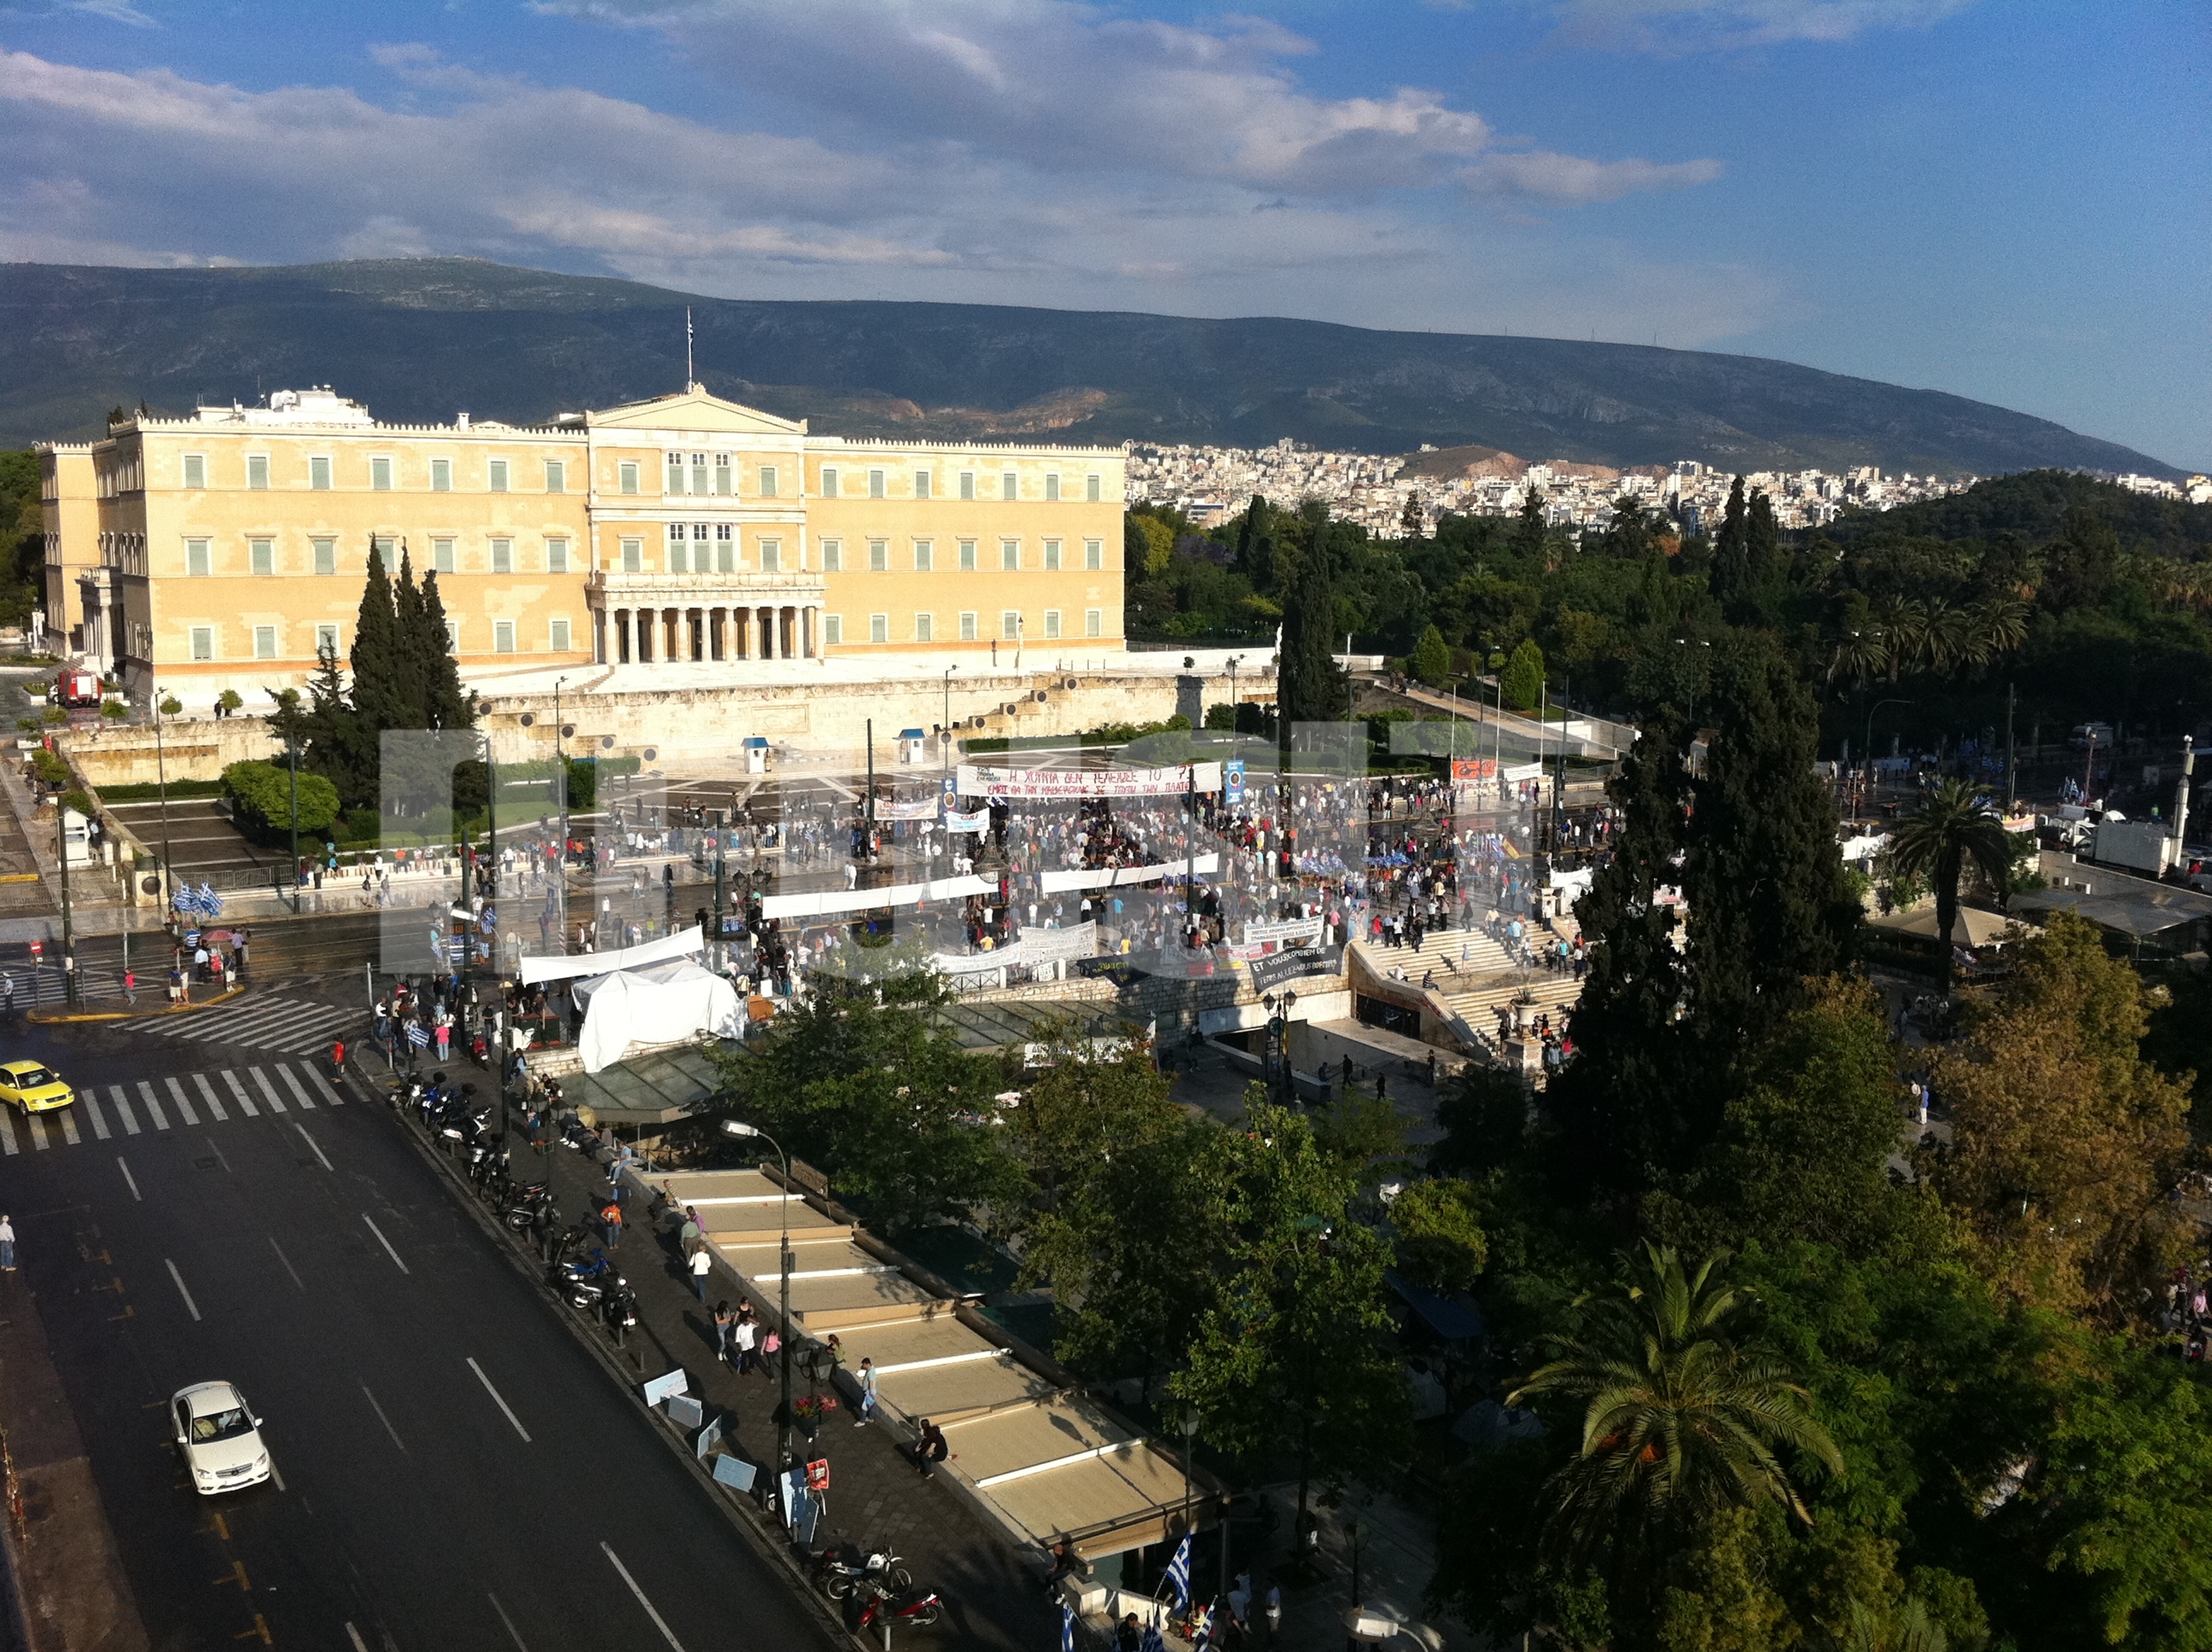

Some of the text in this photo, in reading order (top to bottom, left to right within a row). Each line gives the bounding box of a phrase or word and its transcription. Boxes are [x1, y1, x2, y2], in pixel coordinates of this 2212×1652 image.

[1009, 769, 1017, 782] Η
[1024, 771, 1059, 784] ΧΟΥΝΤΑ
[1064, 772, 1083, 784] ΔΕΝ
[1011, 785, 1021, 794] ΘΑ
[1252, 962, 1264, 972] ET
